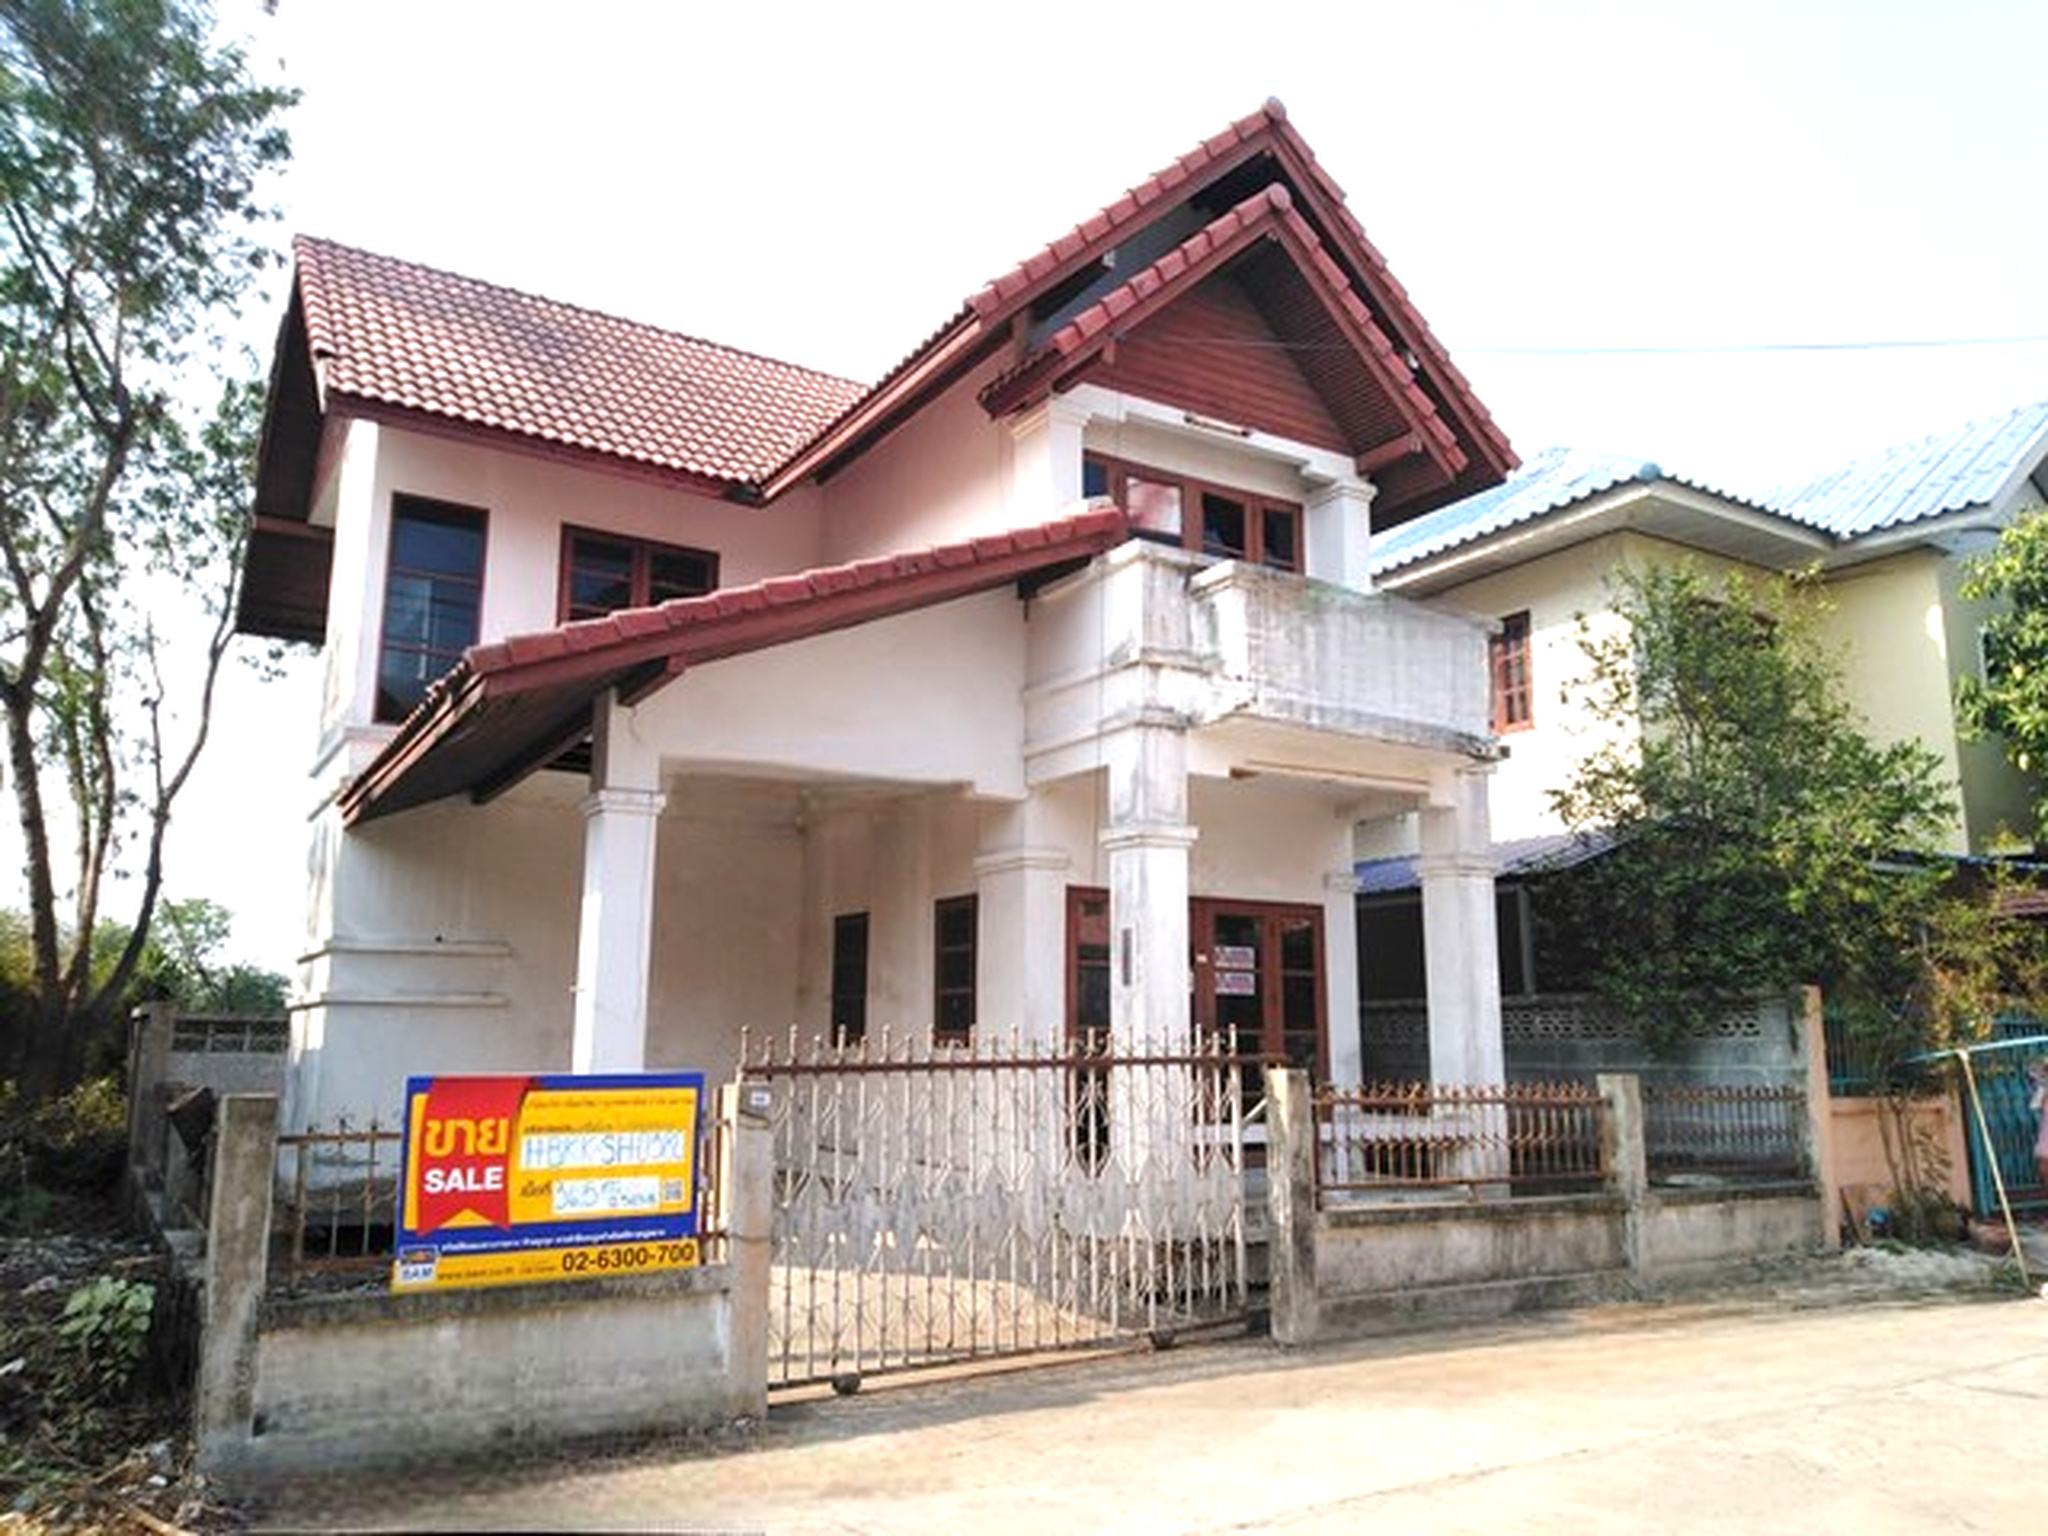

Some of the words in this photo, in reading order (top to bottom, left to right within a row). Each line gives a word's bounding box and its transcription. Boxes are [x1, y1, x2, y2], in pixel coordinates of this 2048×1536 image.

[426, 1118, 509, 1156] ขาย
[424, 1165, 504, 1194] SALE
[561, 1242, 696, 1274] 02-6300-700
